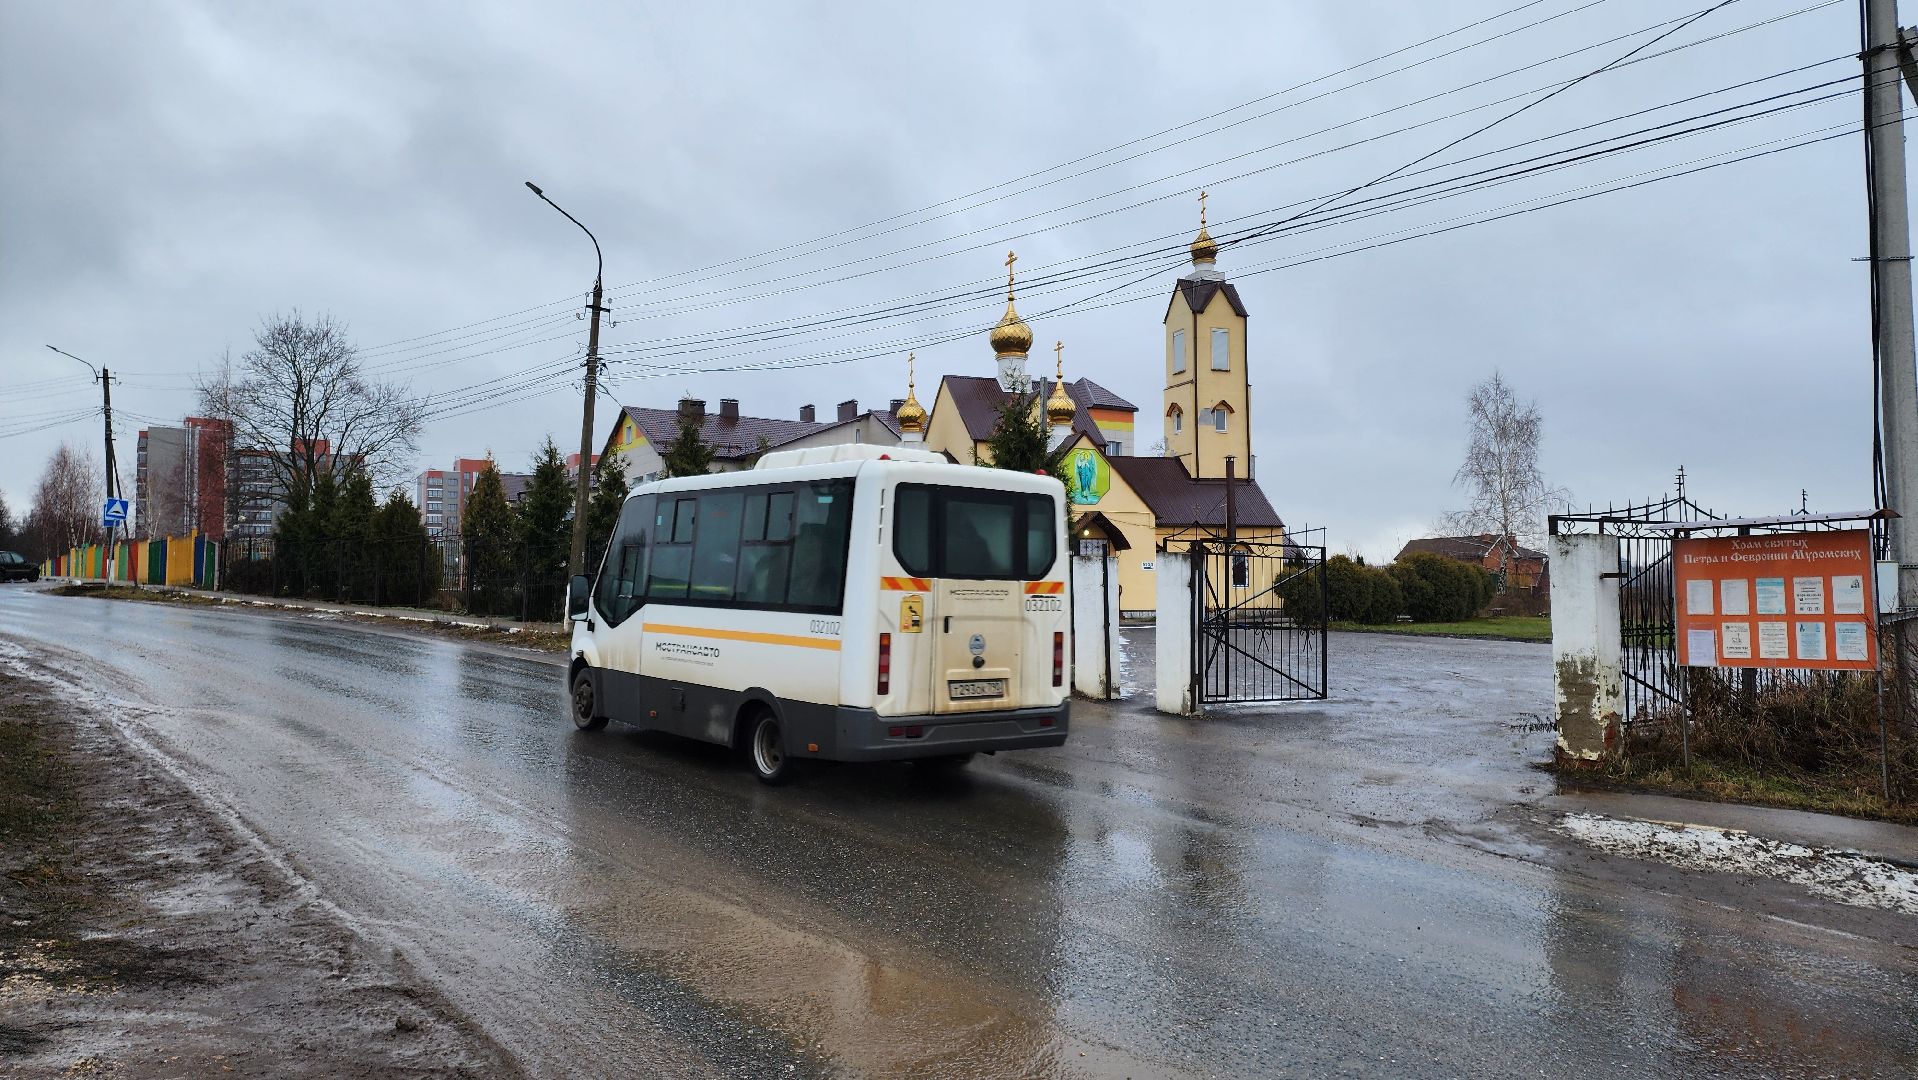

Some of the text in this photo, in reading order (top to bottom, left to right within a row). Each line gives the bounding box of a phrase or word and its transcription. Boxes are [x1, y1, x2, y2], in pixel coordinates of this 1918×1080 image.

[1731, 538, 1809, 551] Храм святых
[1684, 549, 1862, 565] Петра и Февронии Муромских
[1025, 599, 1062, 612] 032102
[810, 619, 841, 635] 032102
